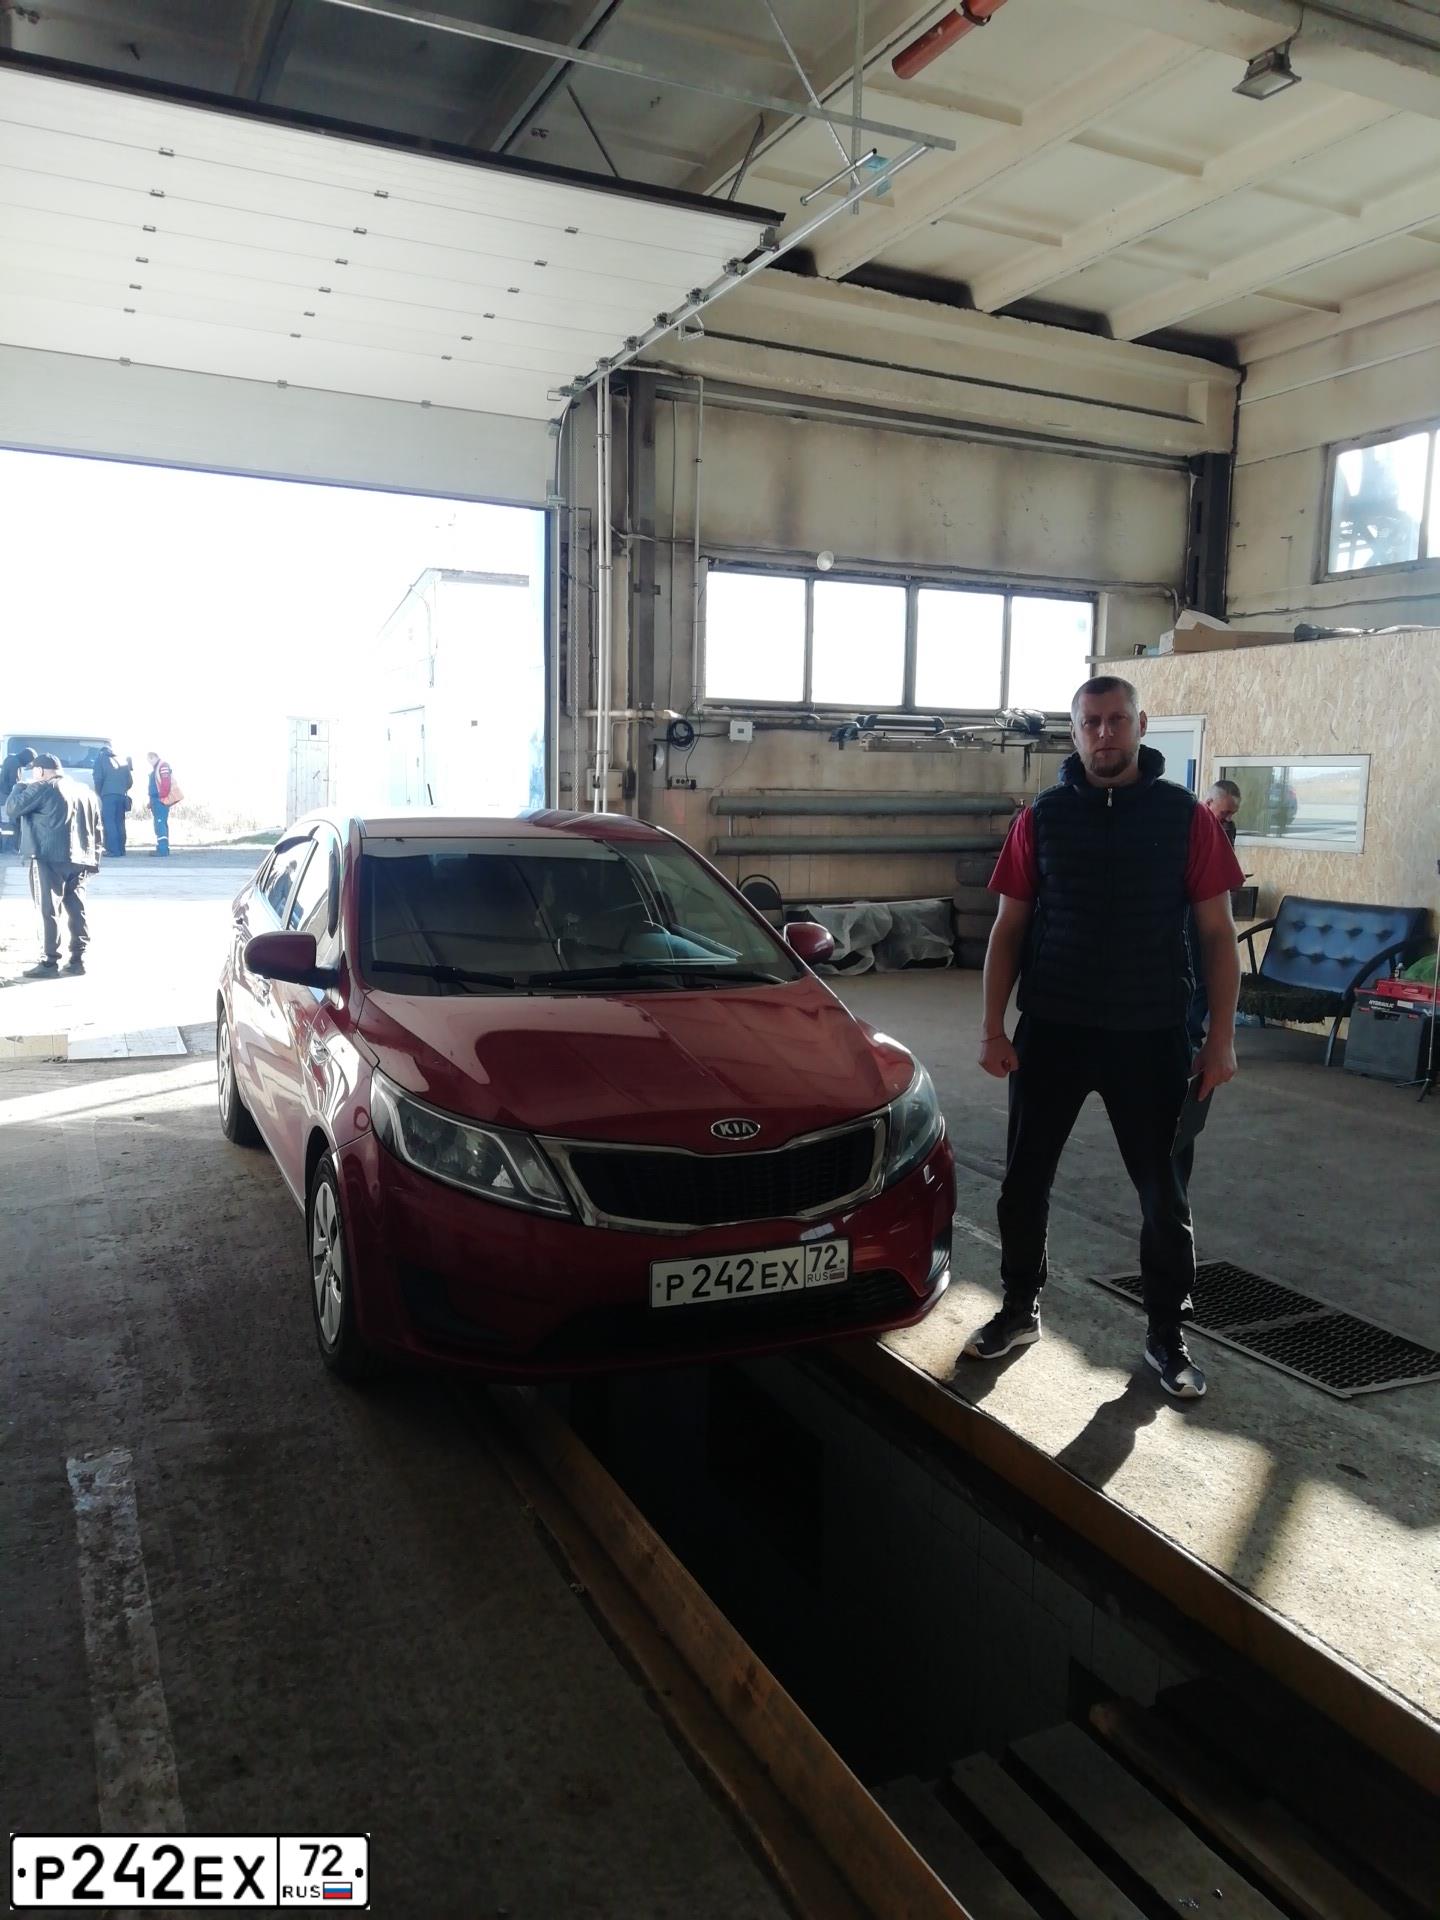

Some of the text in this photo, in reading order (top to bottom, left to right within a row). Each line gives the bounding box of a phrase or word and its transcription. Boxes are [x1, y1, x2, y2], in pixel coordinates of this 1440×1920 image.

[719, 1122, 754, 1135] KIA
[665, 1244, 838, 1301] P242EX 72
[807, 1271, 829, 1283] RUS
